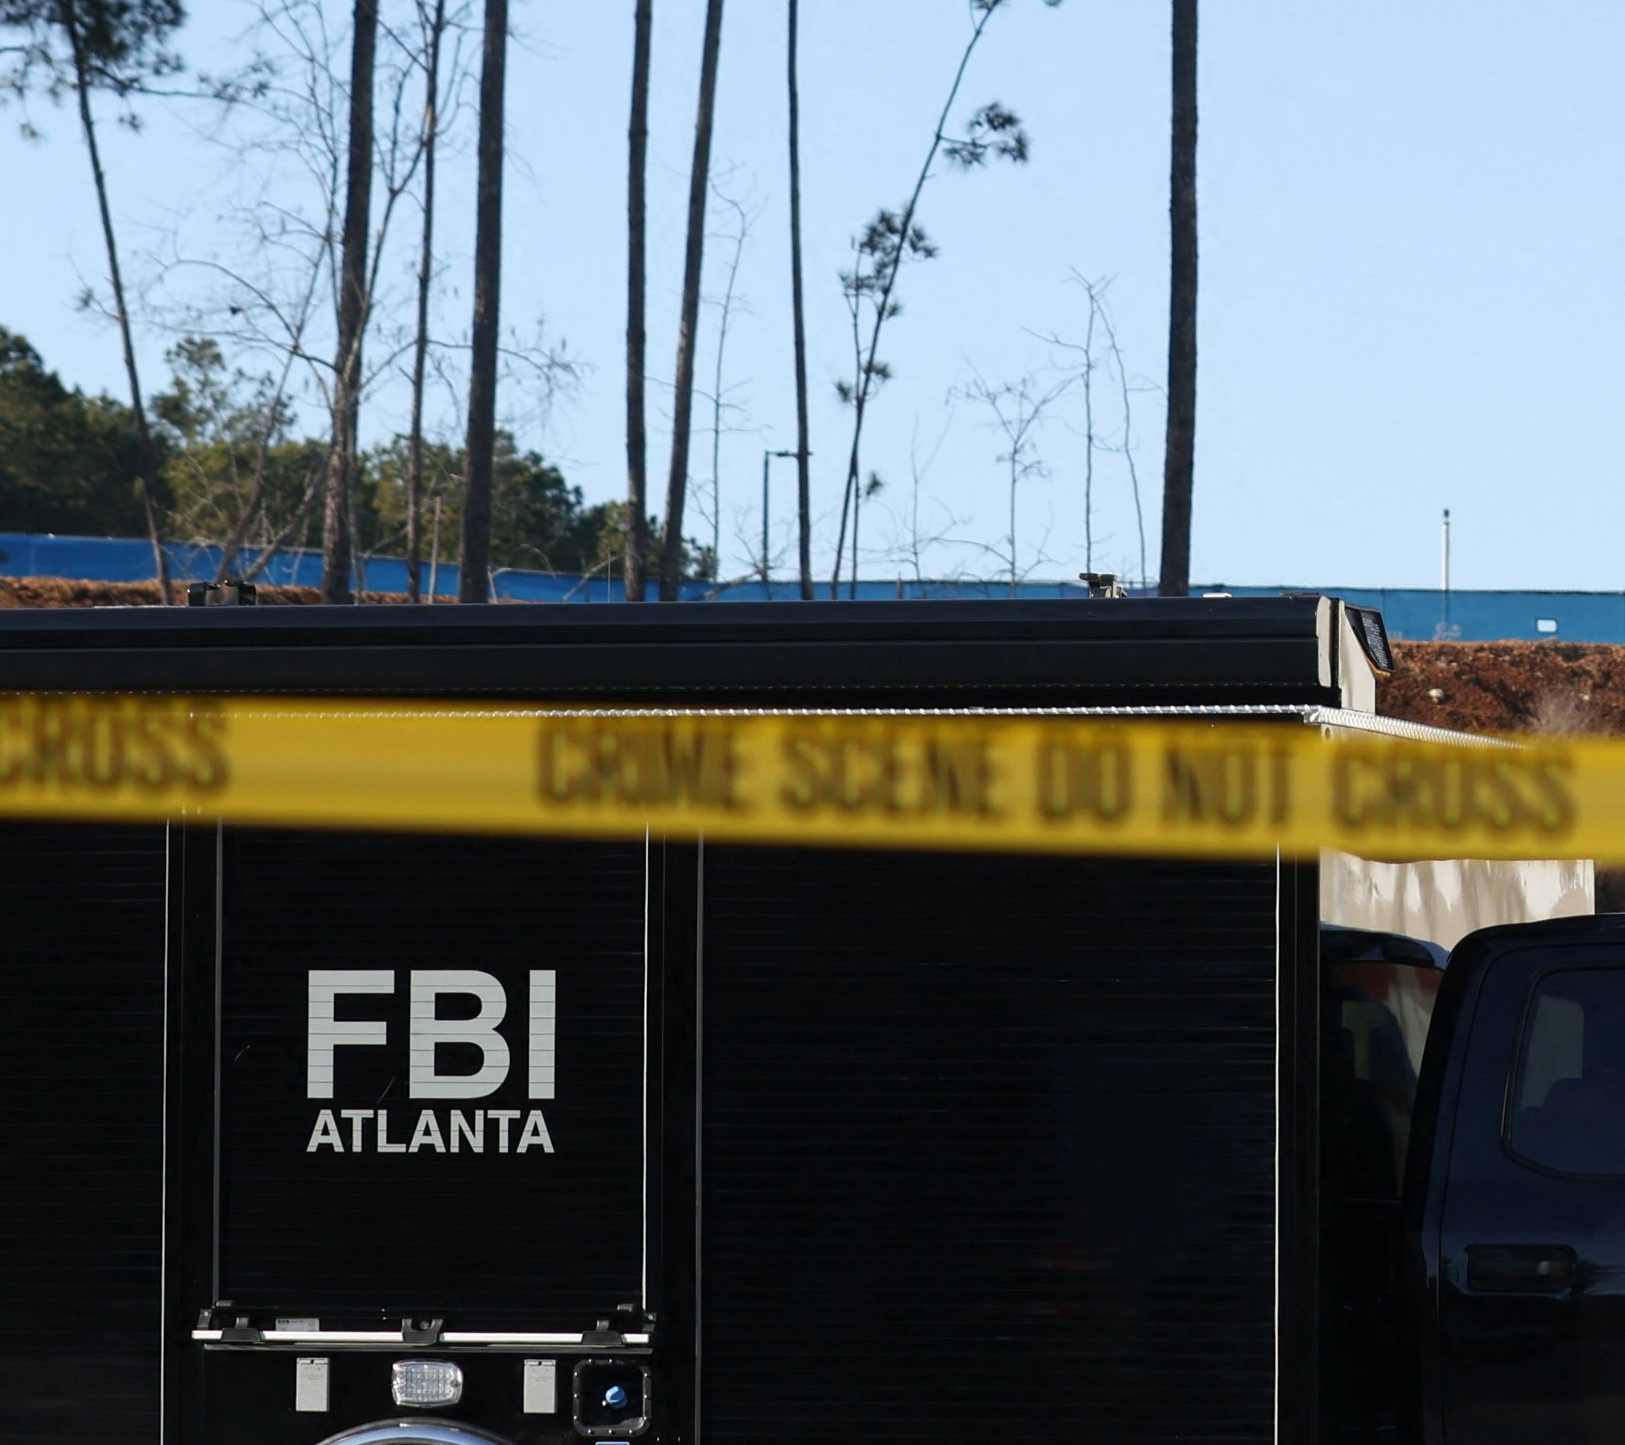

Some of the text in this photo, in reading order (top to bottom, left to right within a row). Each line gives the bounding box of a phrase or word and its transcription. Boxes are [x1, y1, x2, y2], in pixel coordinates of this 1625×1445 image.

[779, 724, 1009, 818] SCENE
[1035, 730, 1134, 825] DO
[1160, 739, 1293, 832] NOT
[1332, 745, 1578, 839] CROSS
[306, 969, 557, 1099] FBI
[306, 1109, 555, 1153] ATLANTA
